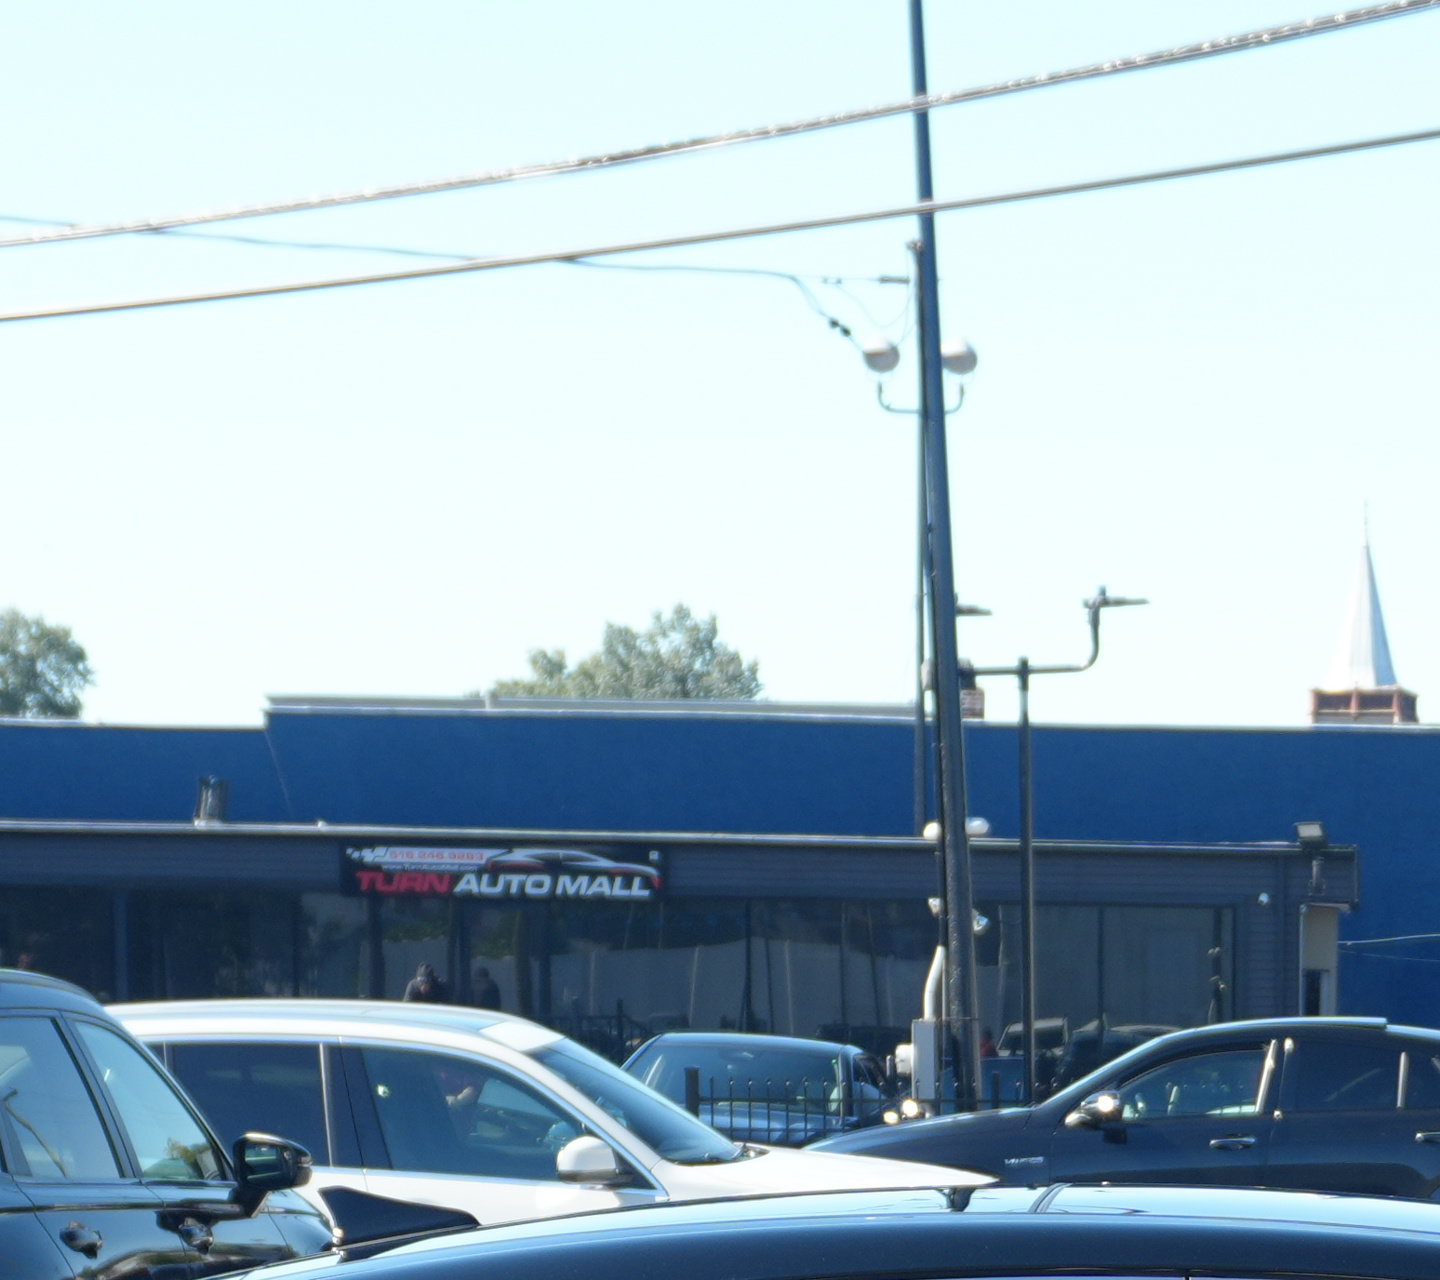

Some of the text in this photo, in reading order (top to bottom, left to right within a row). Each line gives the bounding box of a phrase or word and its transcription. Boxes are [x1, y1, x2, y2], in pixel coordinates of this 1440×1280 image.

[356, 871, 651, 897] TURN AUTO MALL
